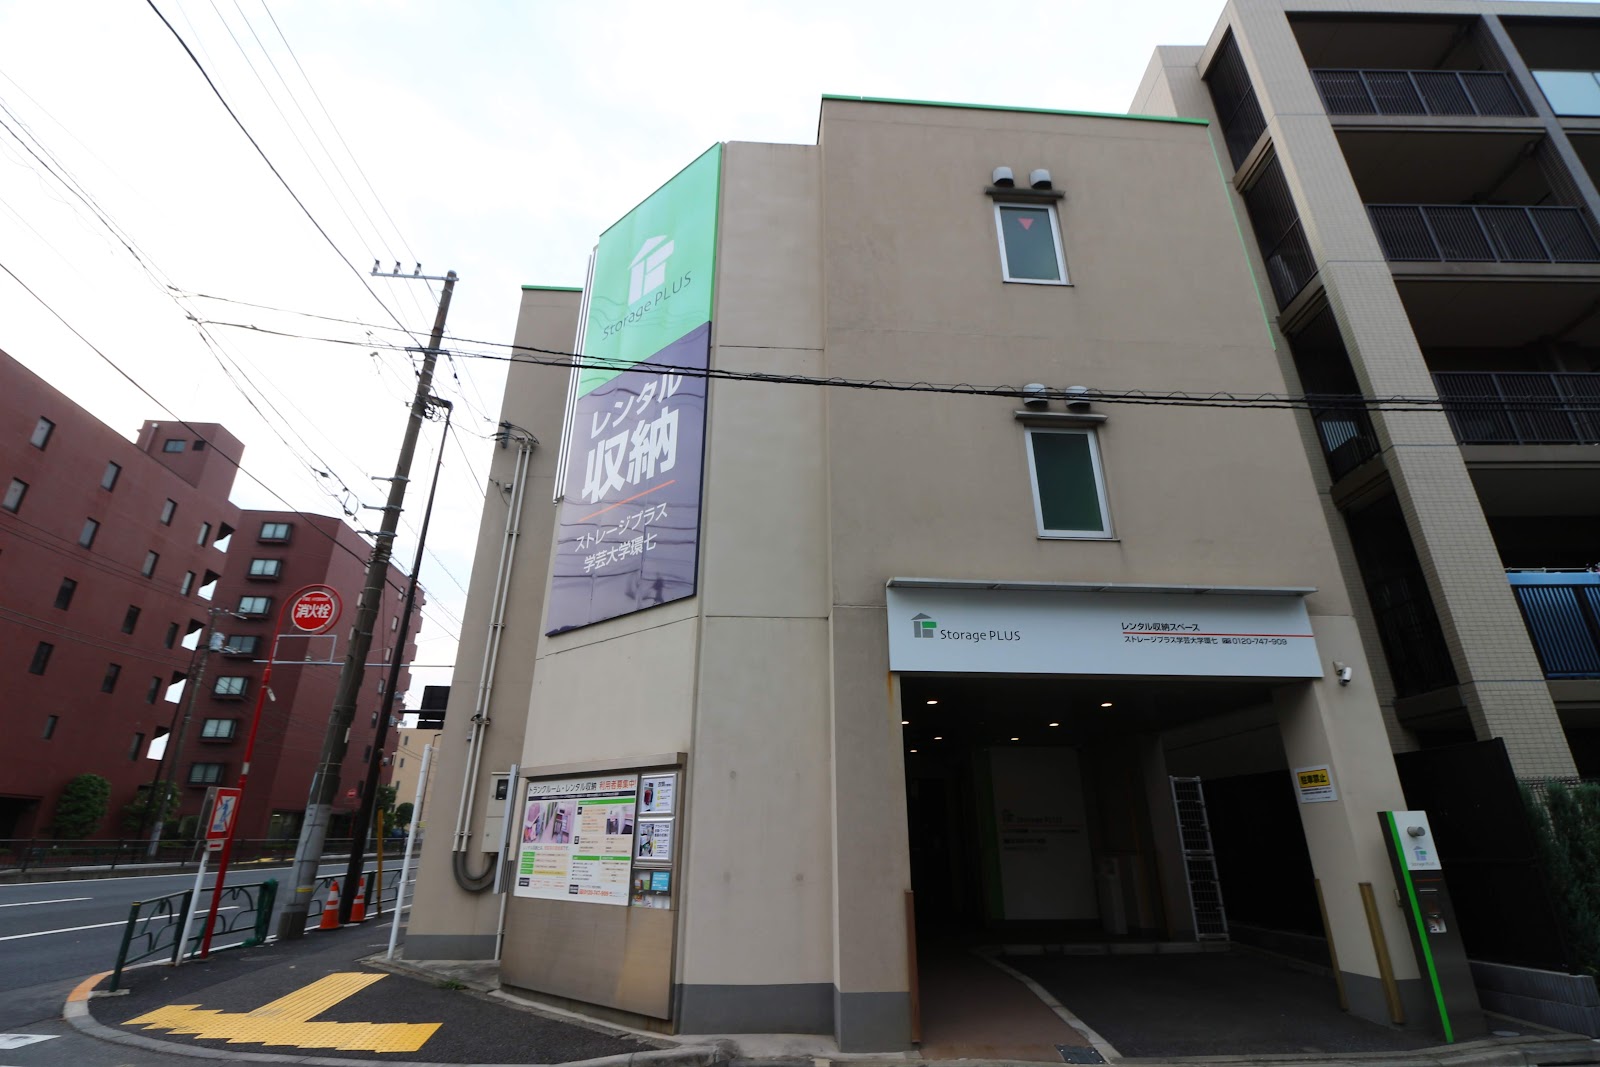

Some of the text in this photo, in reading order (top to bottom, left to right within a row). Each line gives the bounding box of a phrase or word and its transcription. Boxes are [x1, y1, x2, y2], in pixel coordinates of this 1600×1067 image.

[602, 271, 692, 341] Storage PLUS
[591, 368, 683, 439] レンタル
[582, 408, 679, 505] 収納
[574, 502, 668, 553] ストレージプラス
[584, 533, 657, 573] 学芸大学環七
[295, 603, 331, 618] 消火栓
[1121, 622, 1200, 632] レンタル収納スペース
[940, 629, 1021, 643] Storage PLUS
